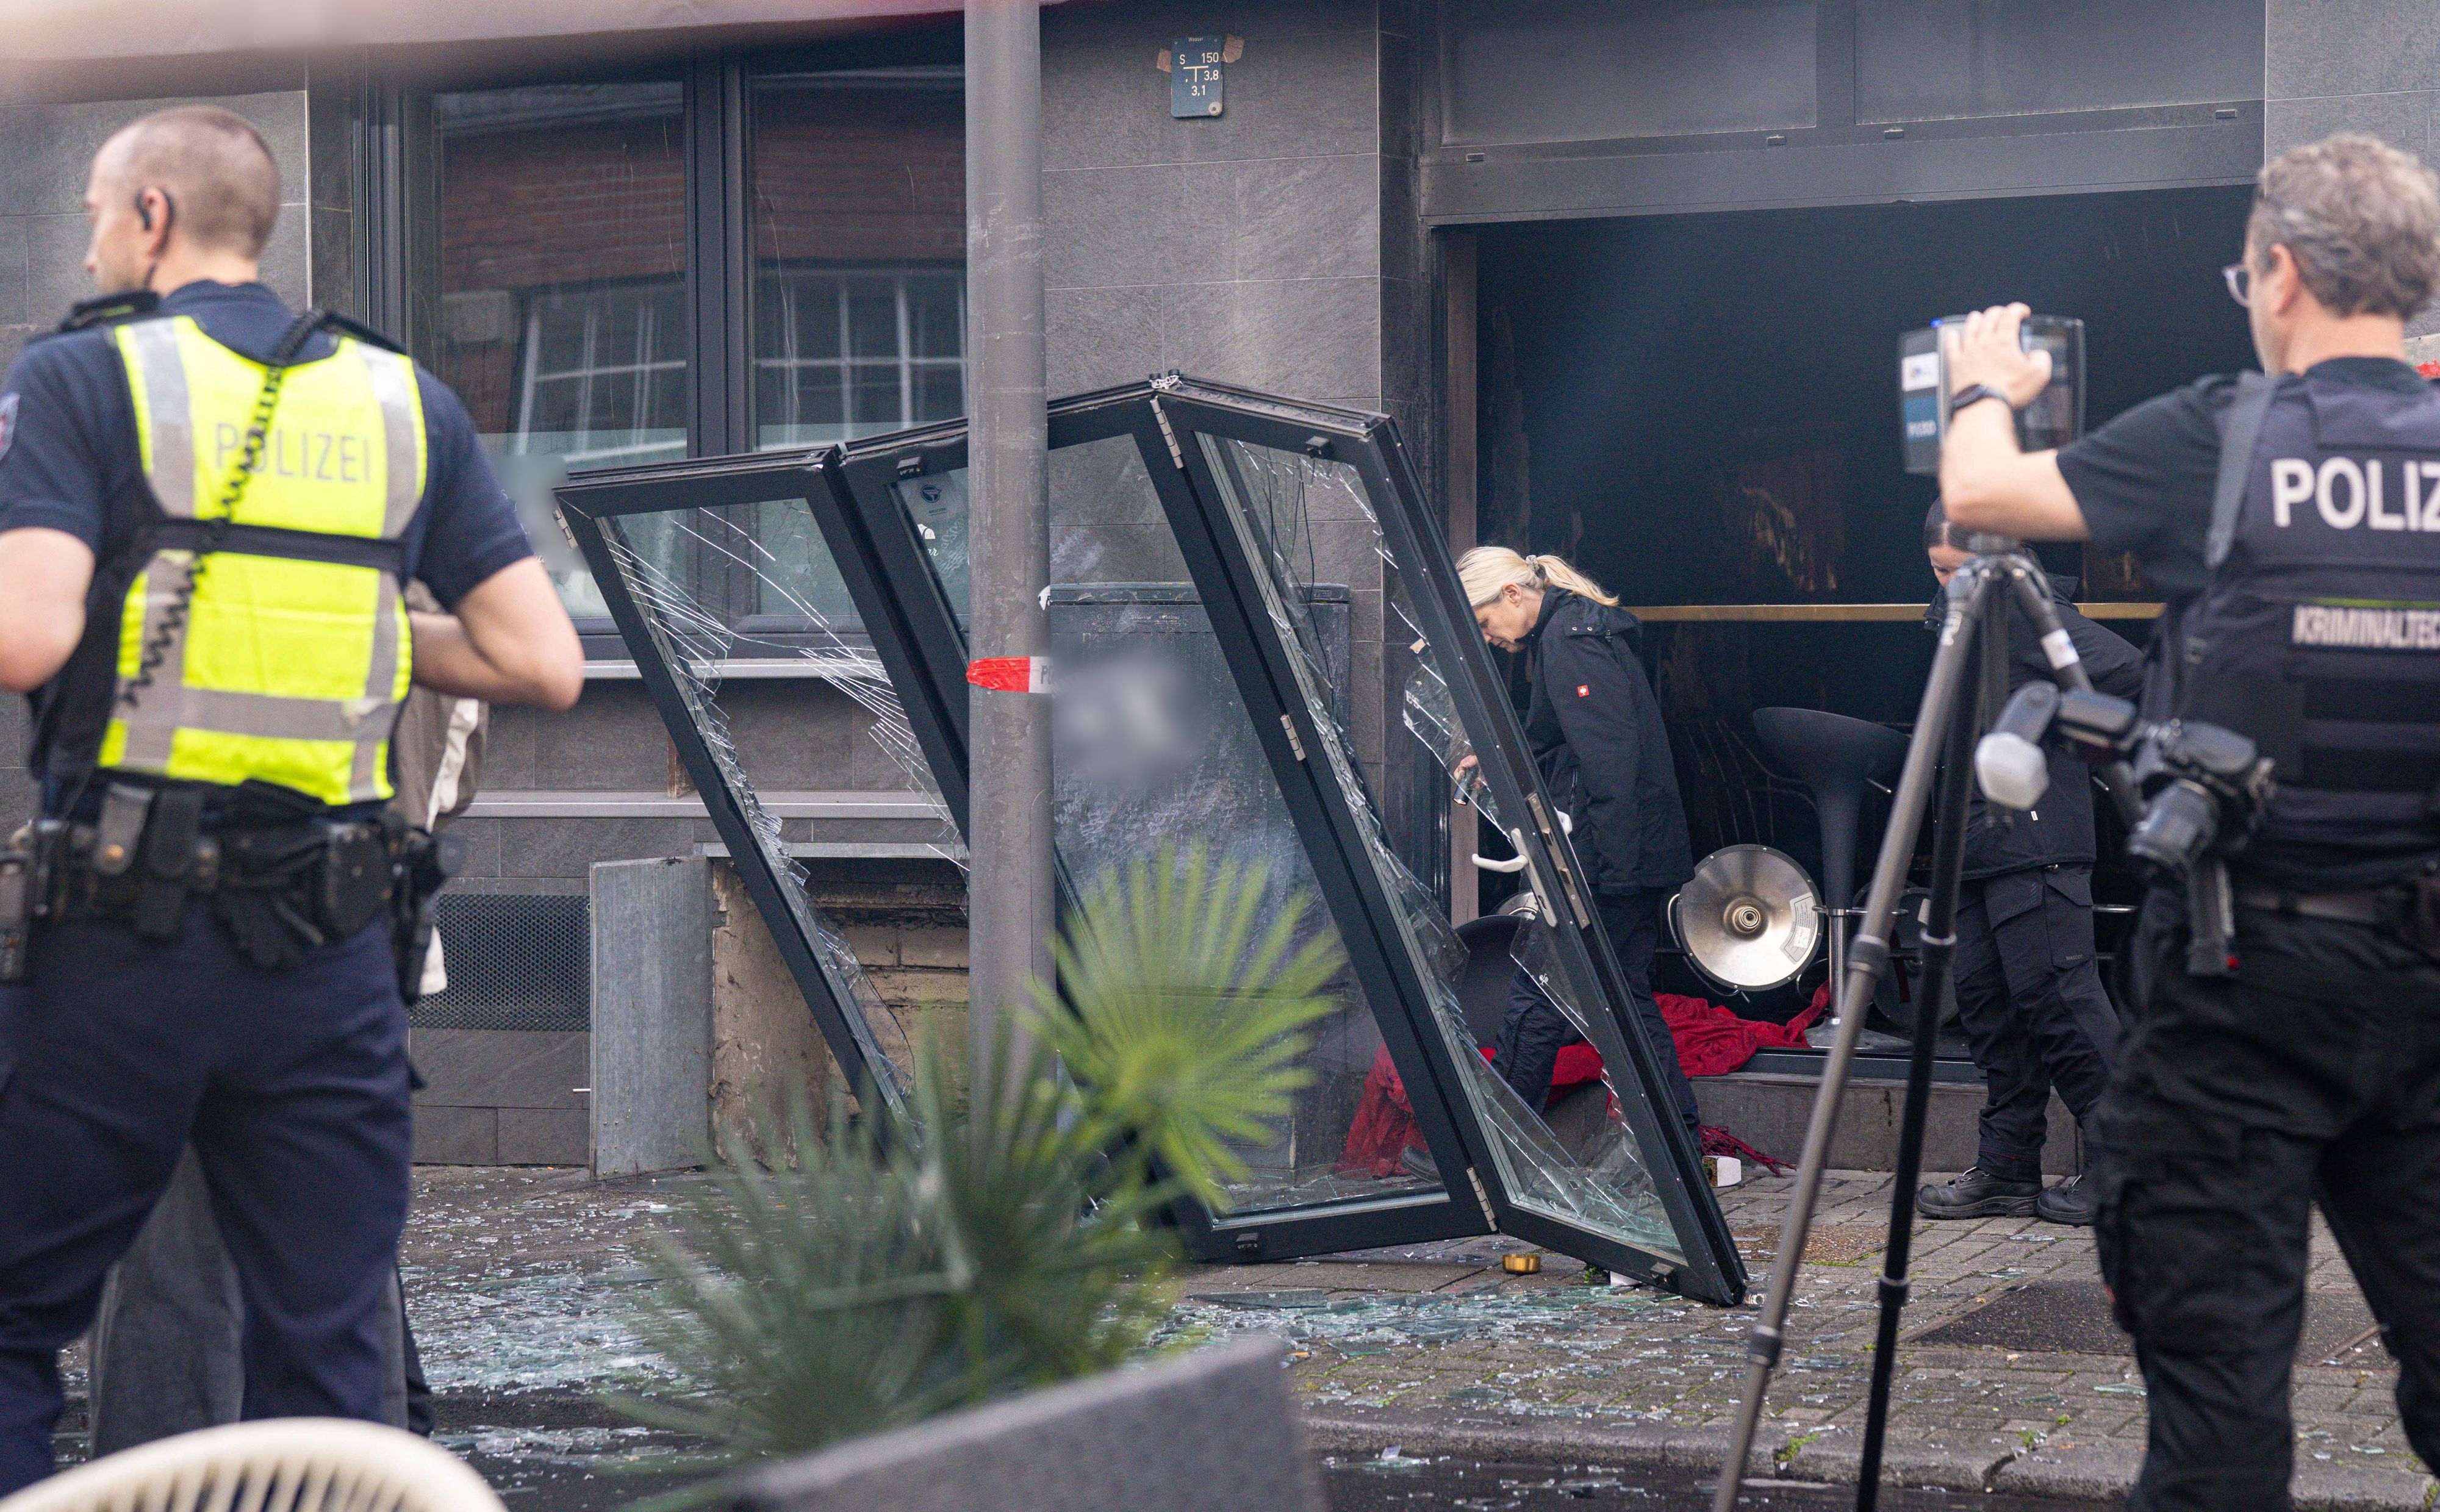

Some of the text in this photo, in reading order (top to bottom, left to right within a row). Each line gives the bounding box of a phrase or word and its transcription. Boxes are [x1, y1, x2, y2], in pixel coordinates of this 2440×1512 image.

[1180, 52, 1219, 65] S 150
[1204, 70, 1219, 81] 3,8
[1191, 85, 1205, 96] 3,1
[217, 422, 371, 484] POLIZEI
[2270, 456, 2440, 532] POLIZ
